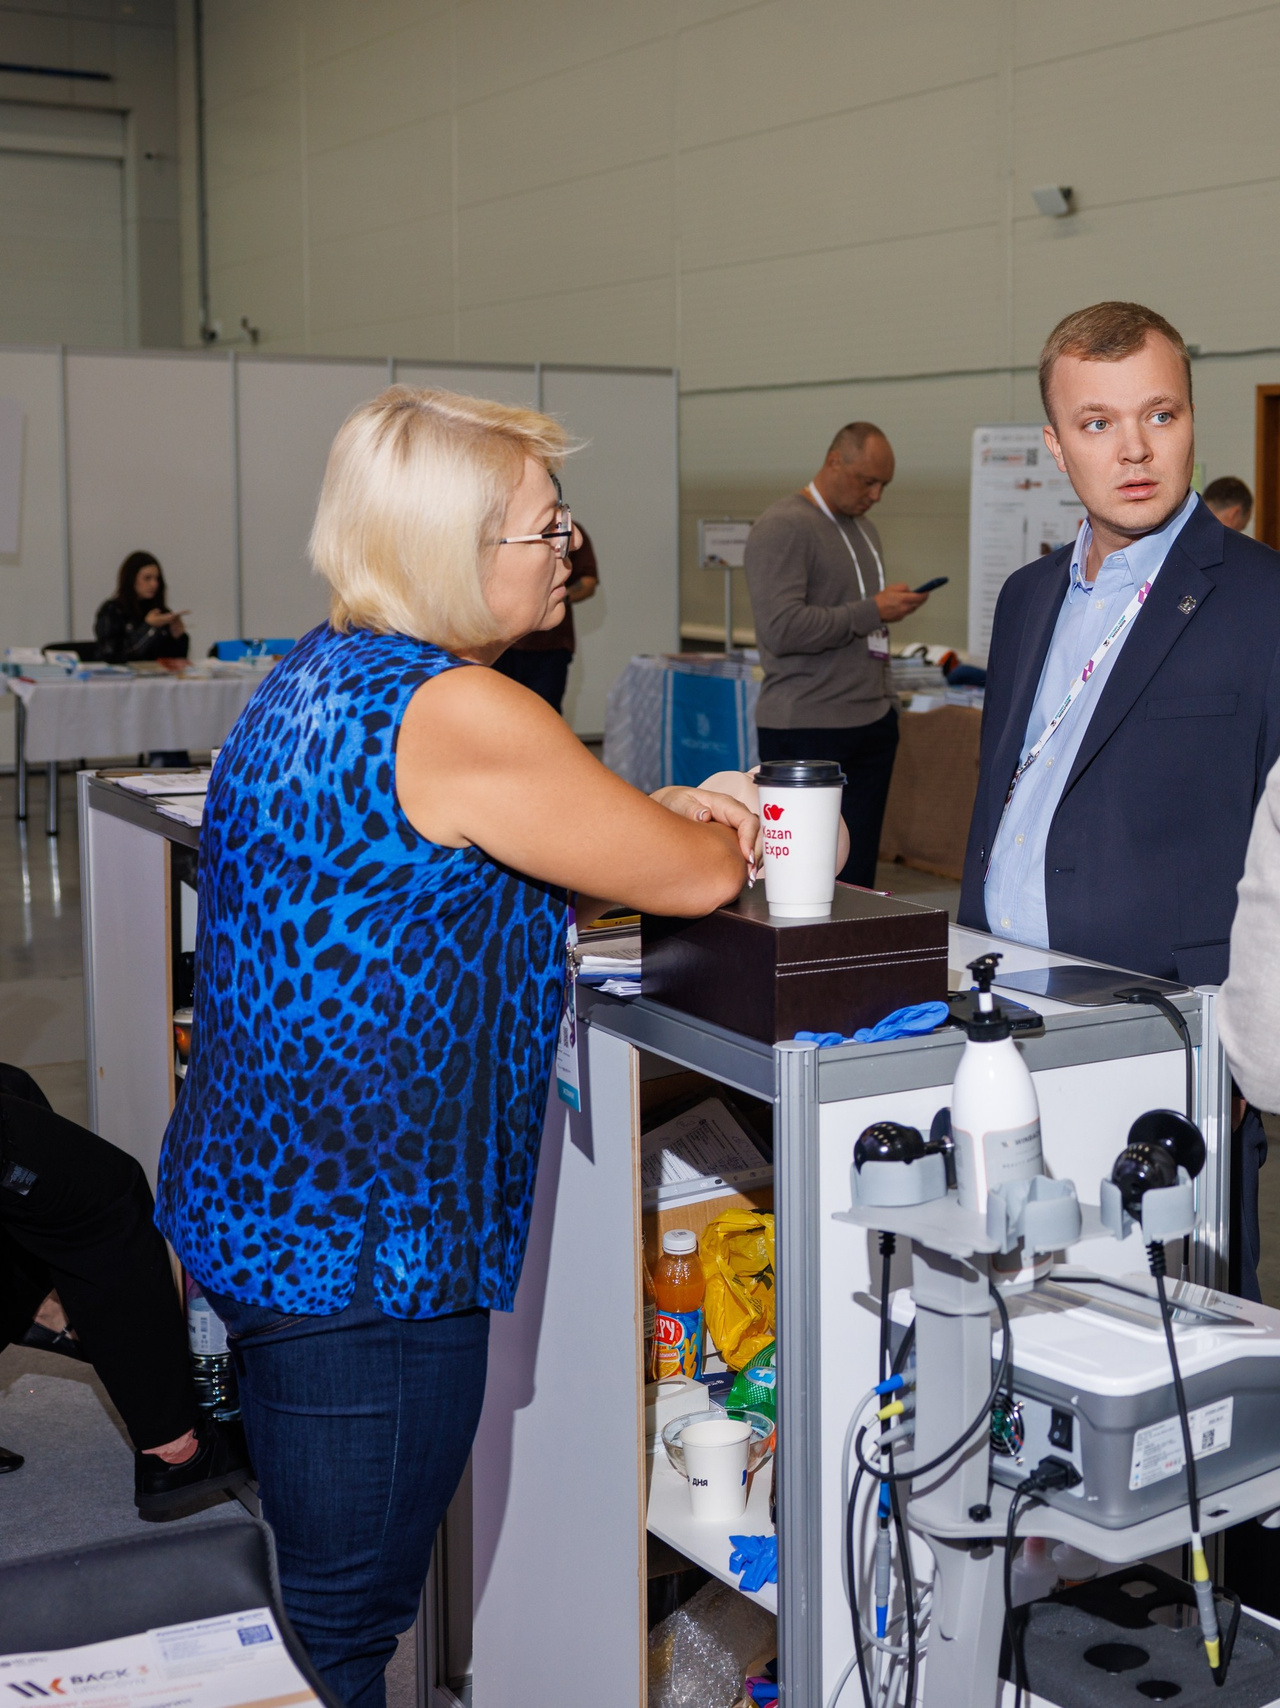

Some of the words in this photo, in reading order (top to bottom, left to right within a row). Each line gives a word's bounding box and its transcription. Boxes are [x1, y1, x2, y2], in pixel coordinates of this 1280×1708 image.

[762, 825, 792, 840] Kazan
[765, 842, 790, 859] Expo
[692, 1477, 708, 1487] ДНЯ
[69, 1667, 129, 1685] BACK
